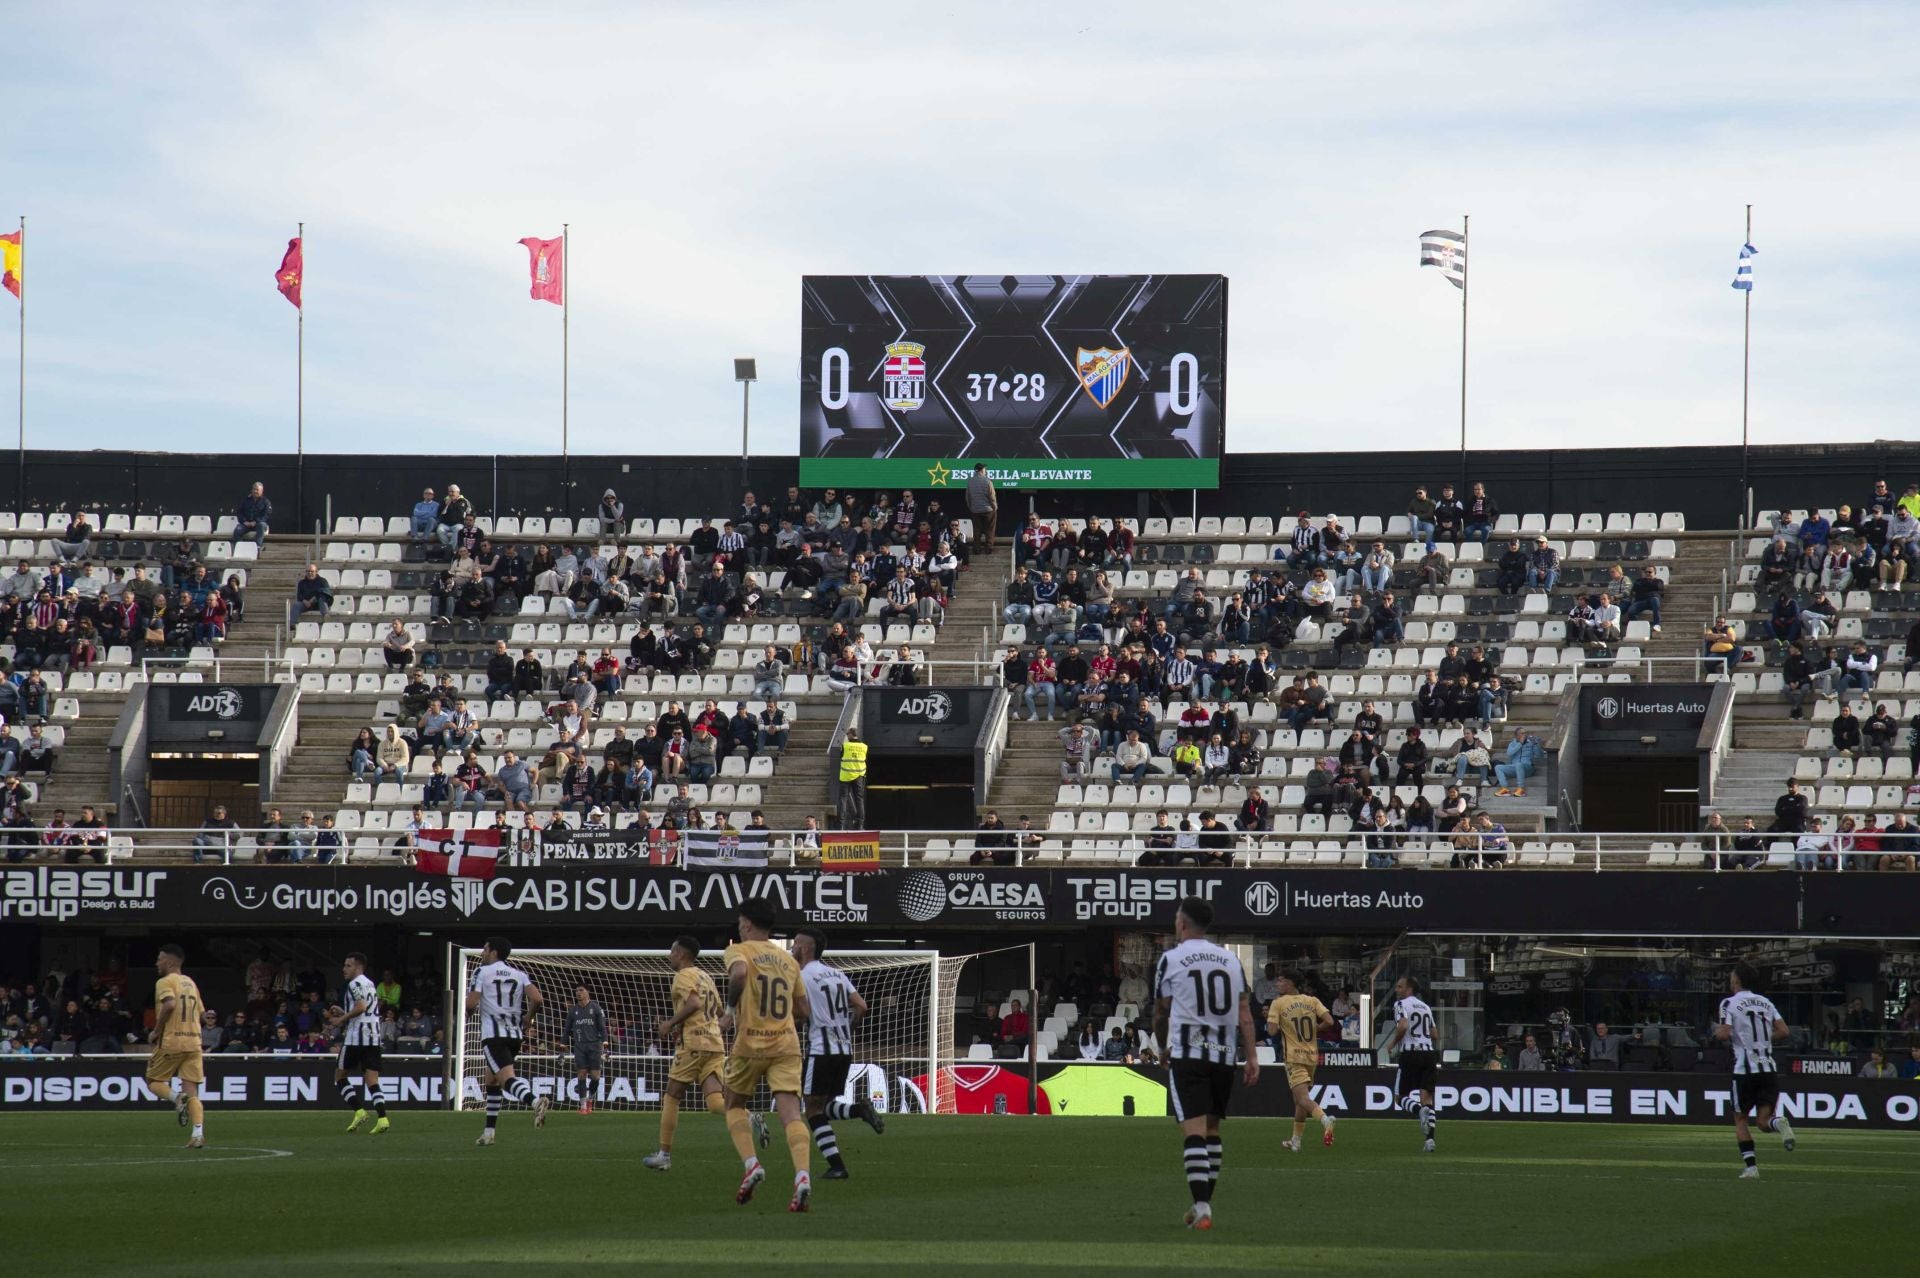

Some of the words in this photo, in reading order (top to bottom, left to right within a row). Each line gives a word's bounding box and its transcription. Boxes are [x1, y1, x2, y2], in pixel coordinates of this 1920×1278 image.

[822, 347, 849, 409] 0
[1170, 352, 1198, 415] 0
[951, 470, 1020, 480] ESTELLA
[1031, 470, 1092, 480] LEVANTE
[187, 695, 226, 712] ADT
[898, 698, 936, 714] ADT
[1598, 698, 1618, 718] MG
[1627, 702, 1674, 713] Huertas
[1677, 702, 1706, 713] Auto
[439, 838, 475, 858] CT
[543, 839, 590, 860] PEÑA
[827, 844, 874, 860] CARTAGENA
[949, 872, 985, 881] GRUPO
[272, 883, 358, 916] Grupo
[366, 882, 447, 916] Inglés
[486, 877, 692, 911] CABISUAR
[699, 873, 868, 910] AVATEL
[948, 883, 1045, 906] CAESA
[1246, 882, 1278, 915] MG
[1294, 890, 1371, 908] Huertas
[1376, 890, 1424, 909] Auto
[0, 899, 79, 922] roup
[81, 899, 117, 911] Design
[119, 900, 128, 909] &
[129, 900, 155, 909] Build
[804, 910, 868, 922] TELECOM
[995, 911, 1046, 920] SEGUROS
[1076, 901, 1152, 920] group
[1180, 952, 1229, 967] ESCRICHE
[492, 978, 519, 1007] 17
[757, 973, 789, 1020] 16
[821, 982, 848, 1021] 14
[1187, 969, 1232, 1017] 10
[1291, 1015, 1314, 1043] 10
[1410, 1011, 1431, 1039] 20
[1745, 1010, 1769, 1042] 11
[1318, 1052, 1372, 1067] #FANCAM
[1792, 1060, 1852, 1075] #FANCAM
[4, 1076, 248, 1101] DISPONLE
[264, 1076, 318, 1101] EN
[1365, 1085, 1612, 1114] DPONIBLE
[1630, 1089, 1687, 1115] EN
[1704, 1090, 1868, 1120] TNDA
